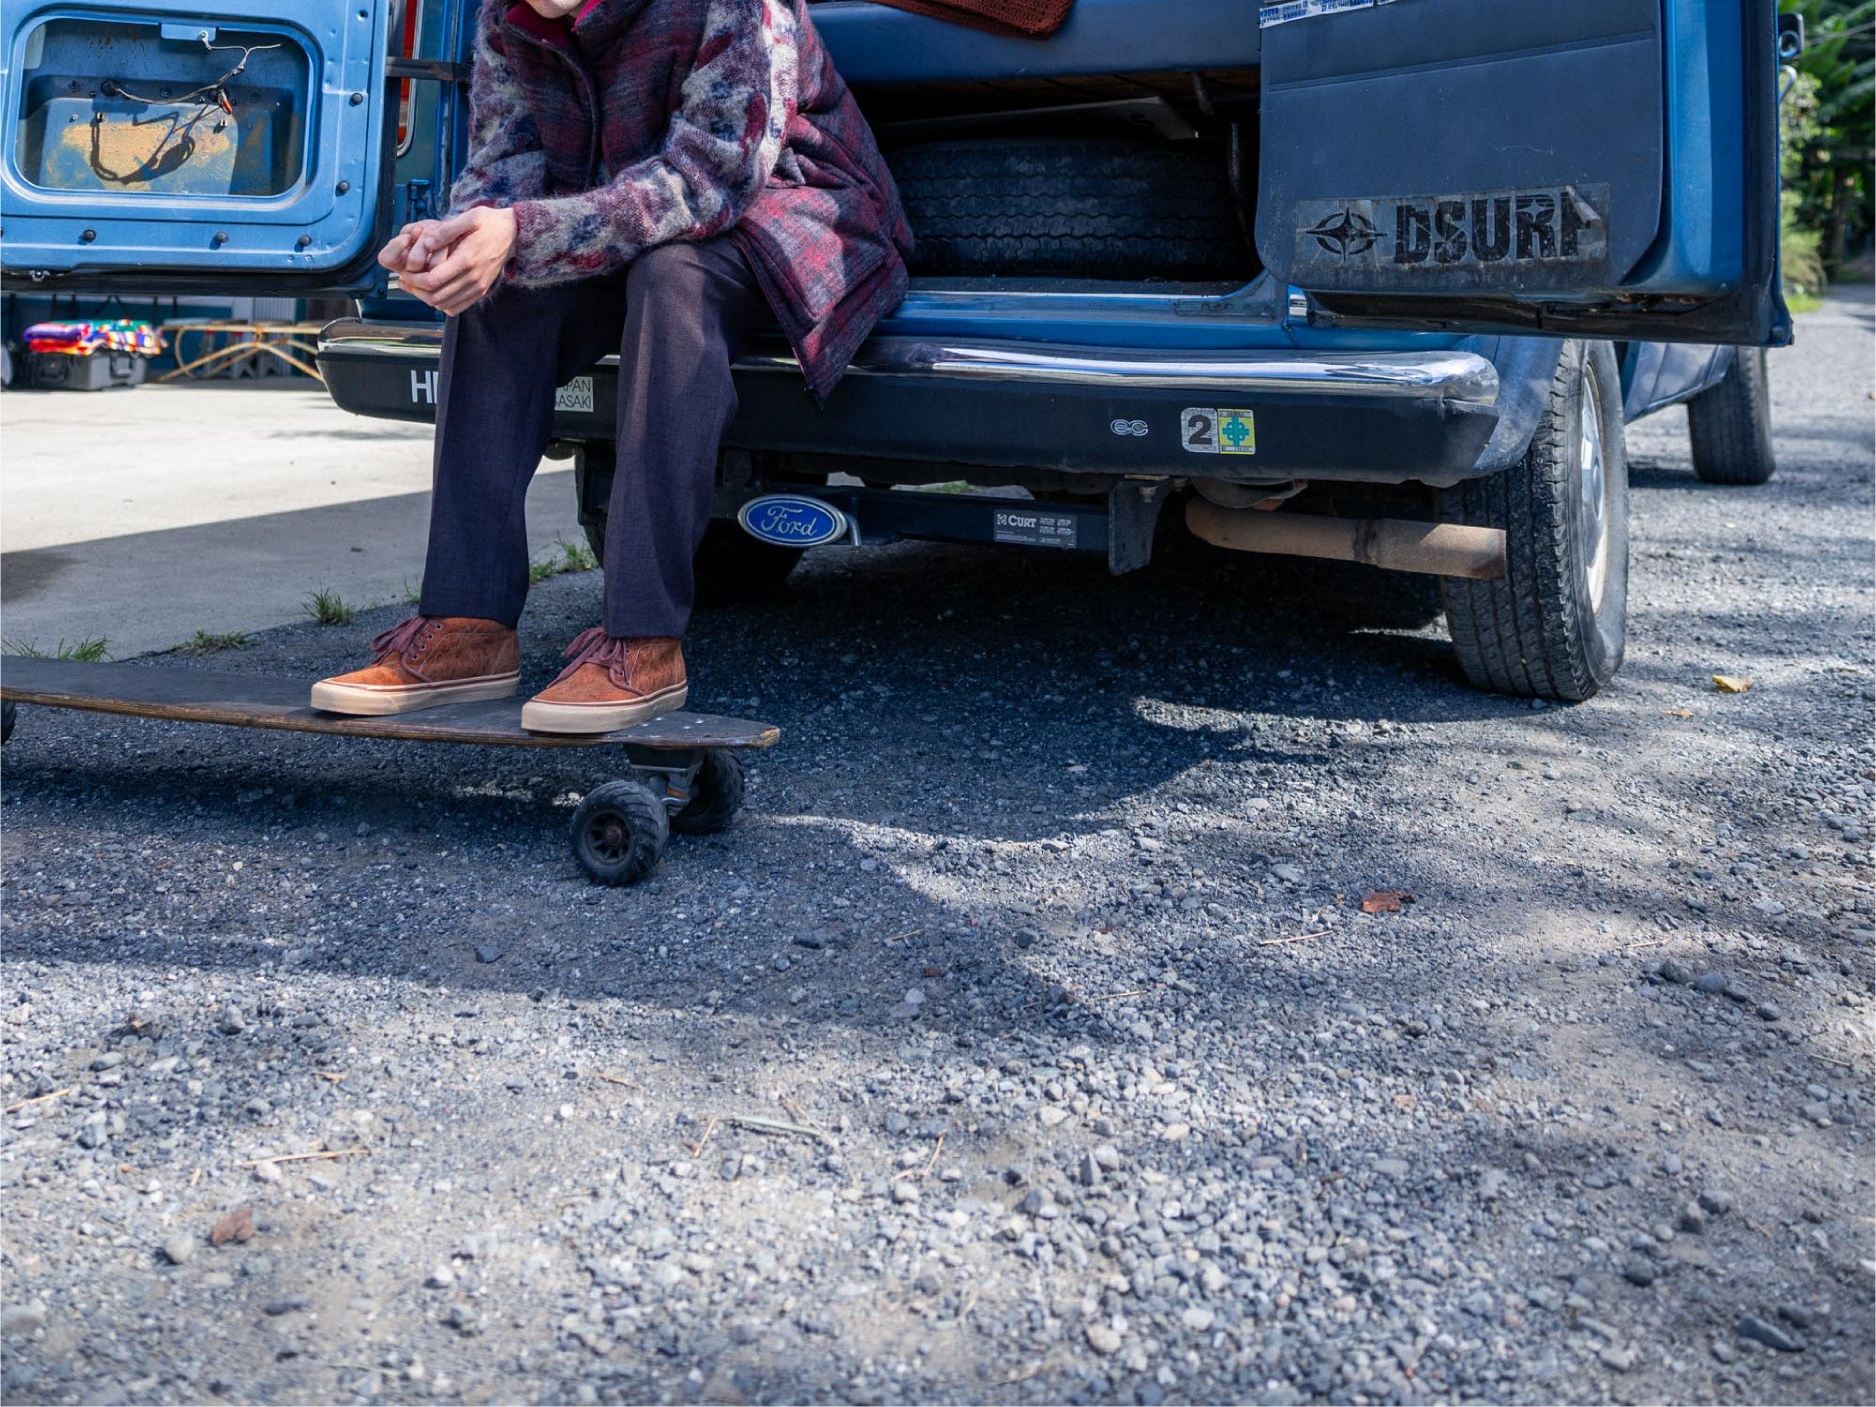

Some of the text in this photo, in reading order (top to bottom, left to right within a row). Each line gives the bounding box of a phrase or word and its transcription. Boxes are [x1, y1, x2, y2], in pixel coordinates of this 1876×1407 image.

[555, 394, 592, 409] ASAKI
[1188, 414, 1213, 445] 2
[761, 505, 819, 537] Ford
[1008, 515, 1037, 528] CURT
